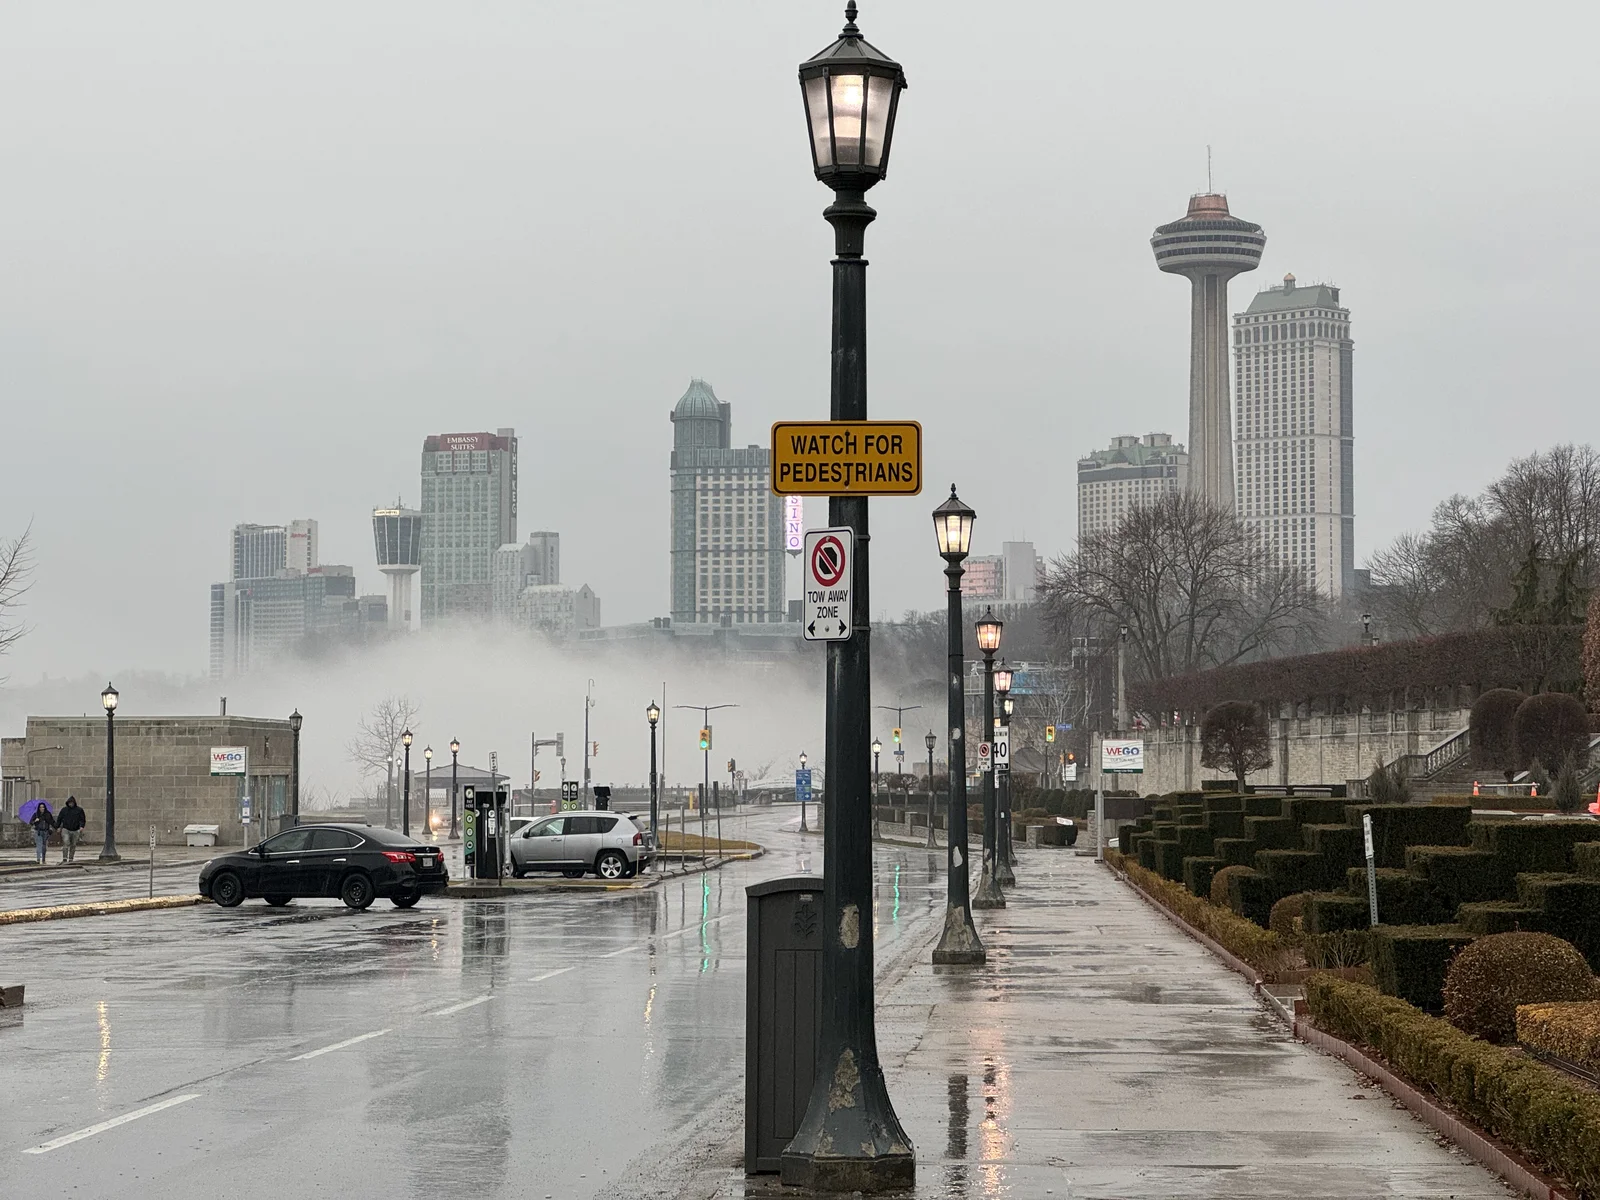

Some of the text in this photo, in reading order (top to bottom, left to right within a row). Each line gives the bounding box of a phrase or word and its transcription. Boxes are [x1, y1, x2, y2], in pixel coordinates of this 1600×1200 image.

[447, 436, 479, 444] EMBASSY
[791, 434, 903, 455] WATCH FOR
[450, 443, 475, 451] SUITES
[779, 462, 913, 483] PEDESTRIANS
[807, 590, 849, 603] TOW AWAY
[817, 606, 839, 618] ZONE
[994, 742, 1007, 758] 40
[1106, 747, 1140, 756] WEGO
[213, 753, 242, 761] WEGO
